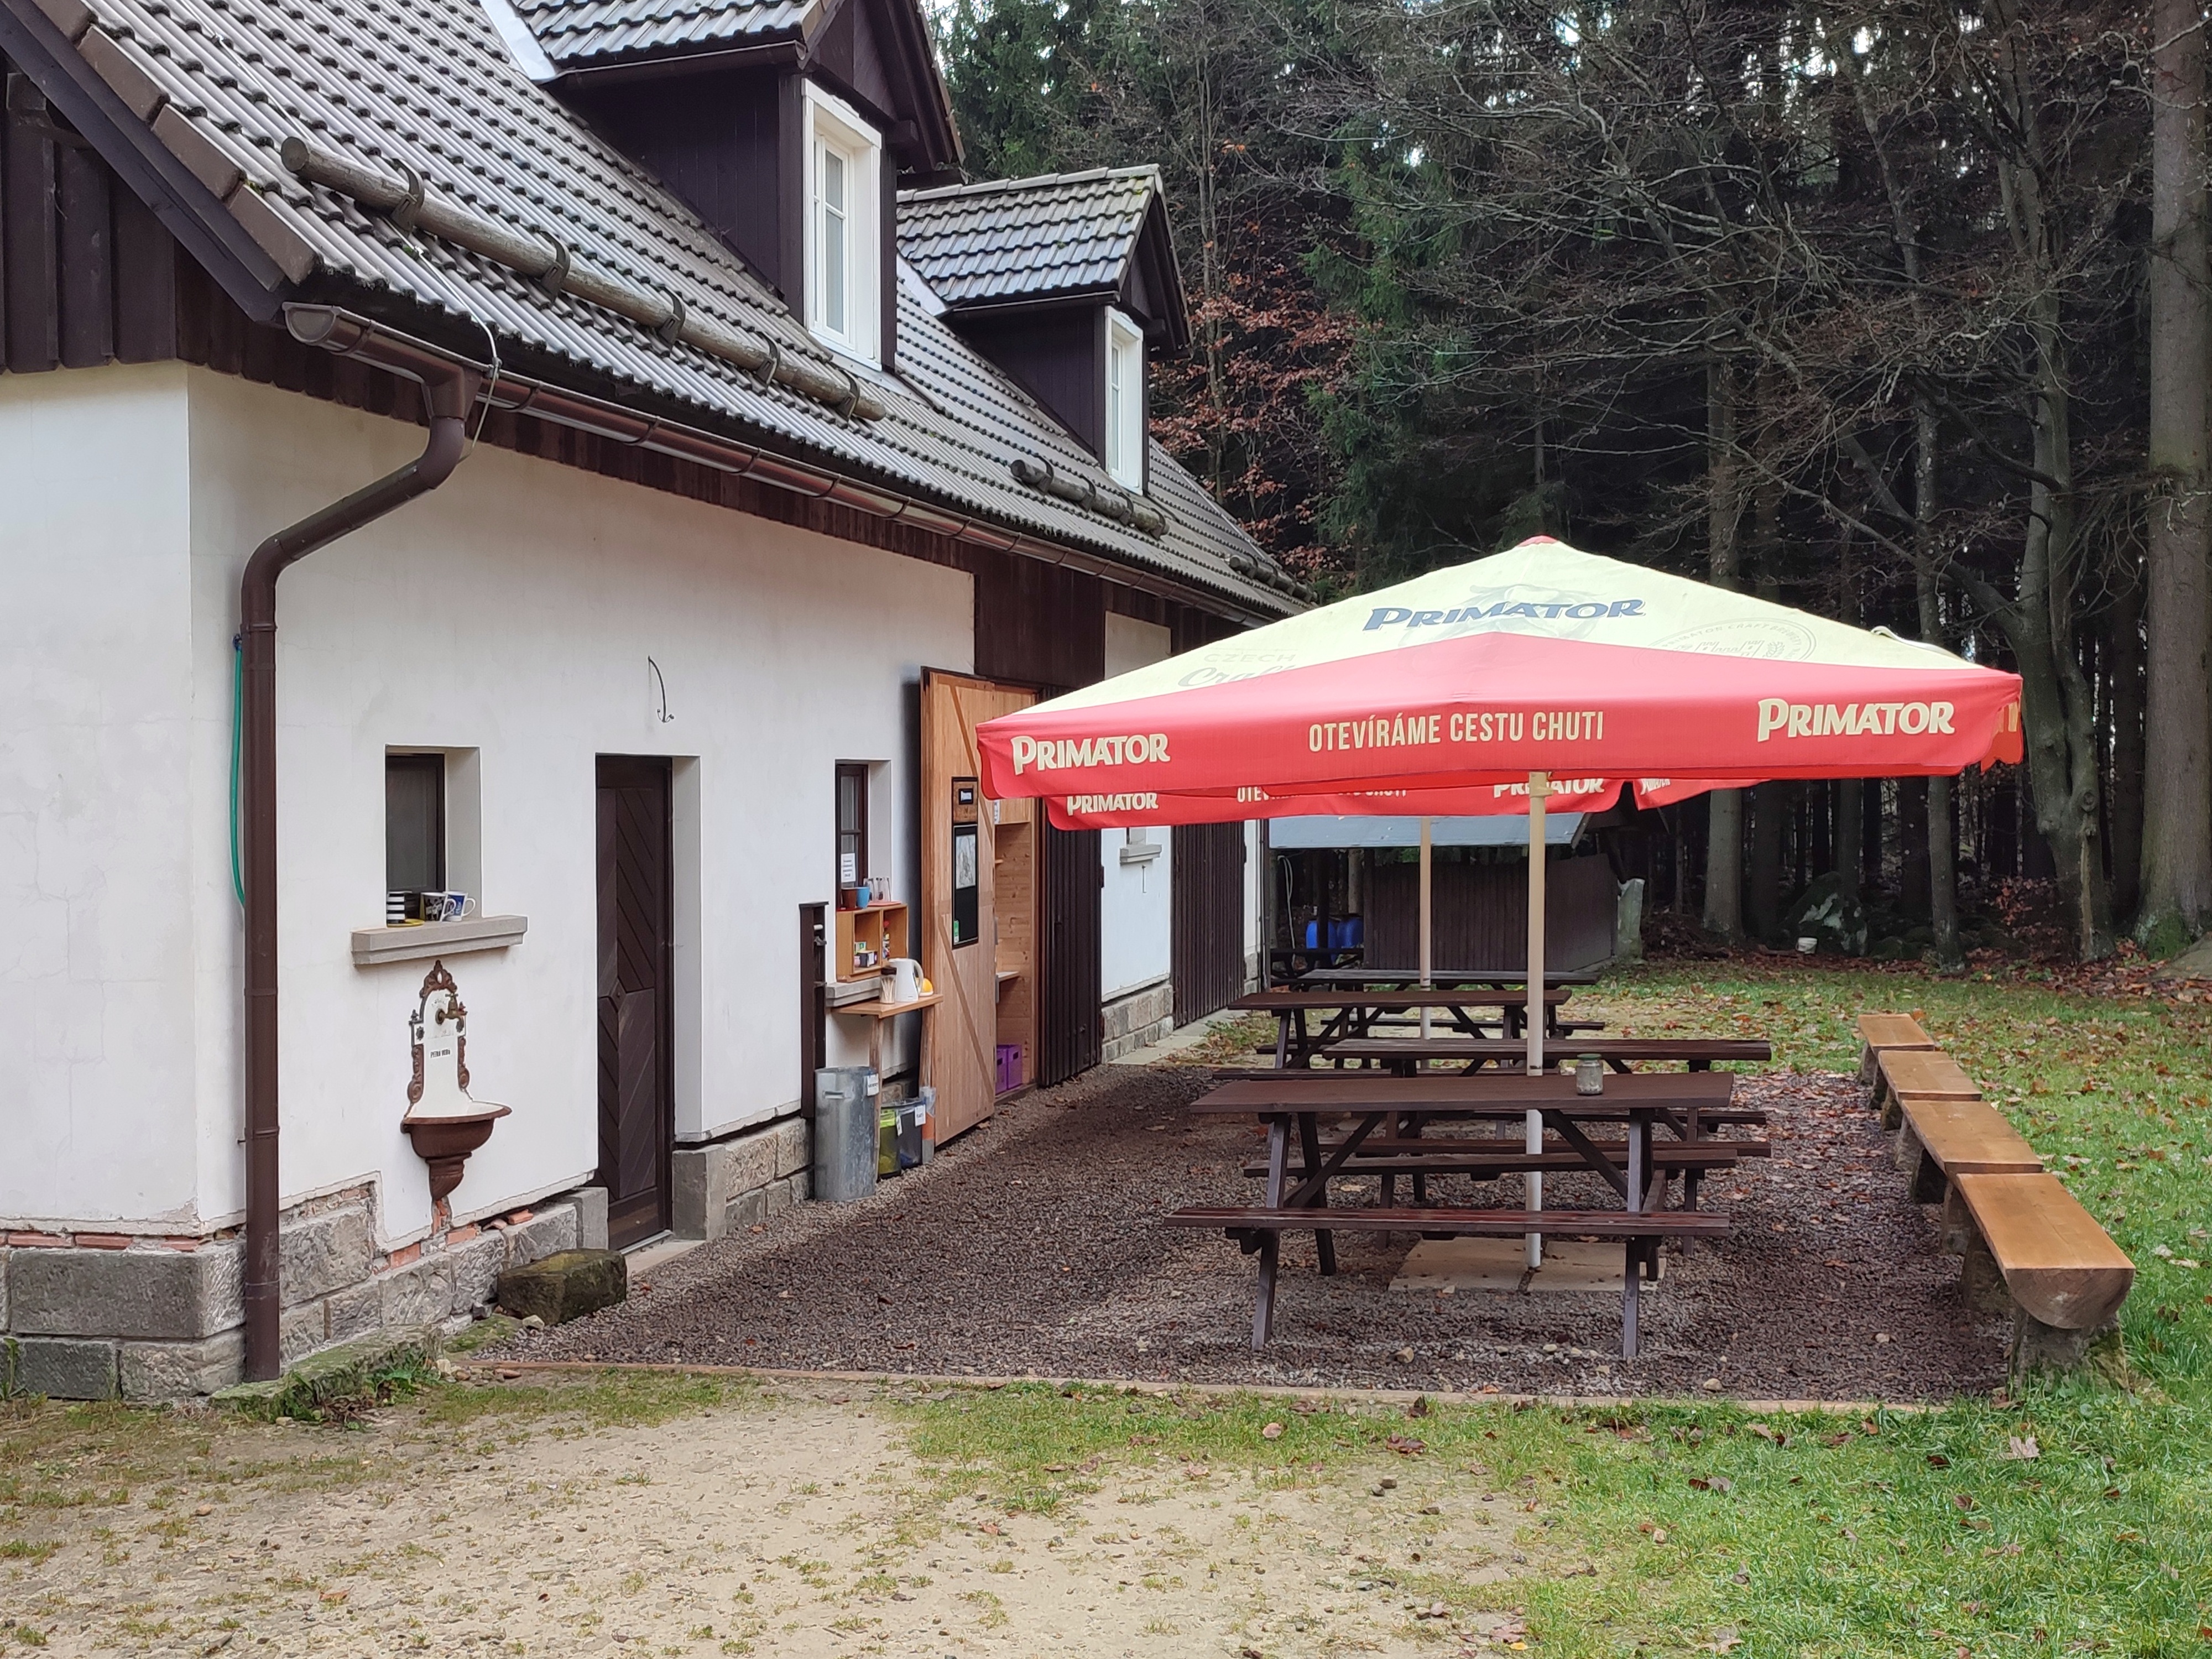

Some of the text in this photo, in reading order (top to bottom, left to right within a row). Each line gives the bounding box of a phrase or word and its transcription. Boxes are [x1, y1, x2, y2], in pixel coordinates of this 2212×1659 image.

[1203, 654, 1296, 662] CZECH
[1308, 711, 1604, 752] OTEVÍRÁME CESTU CHUTI
